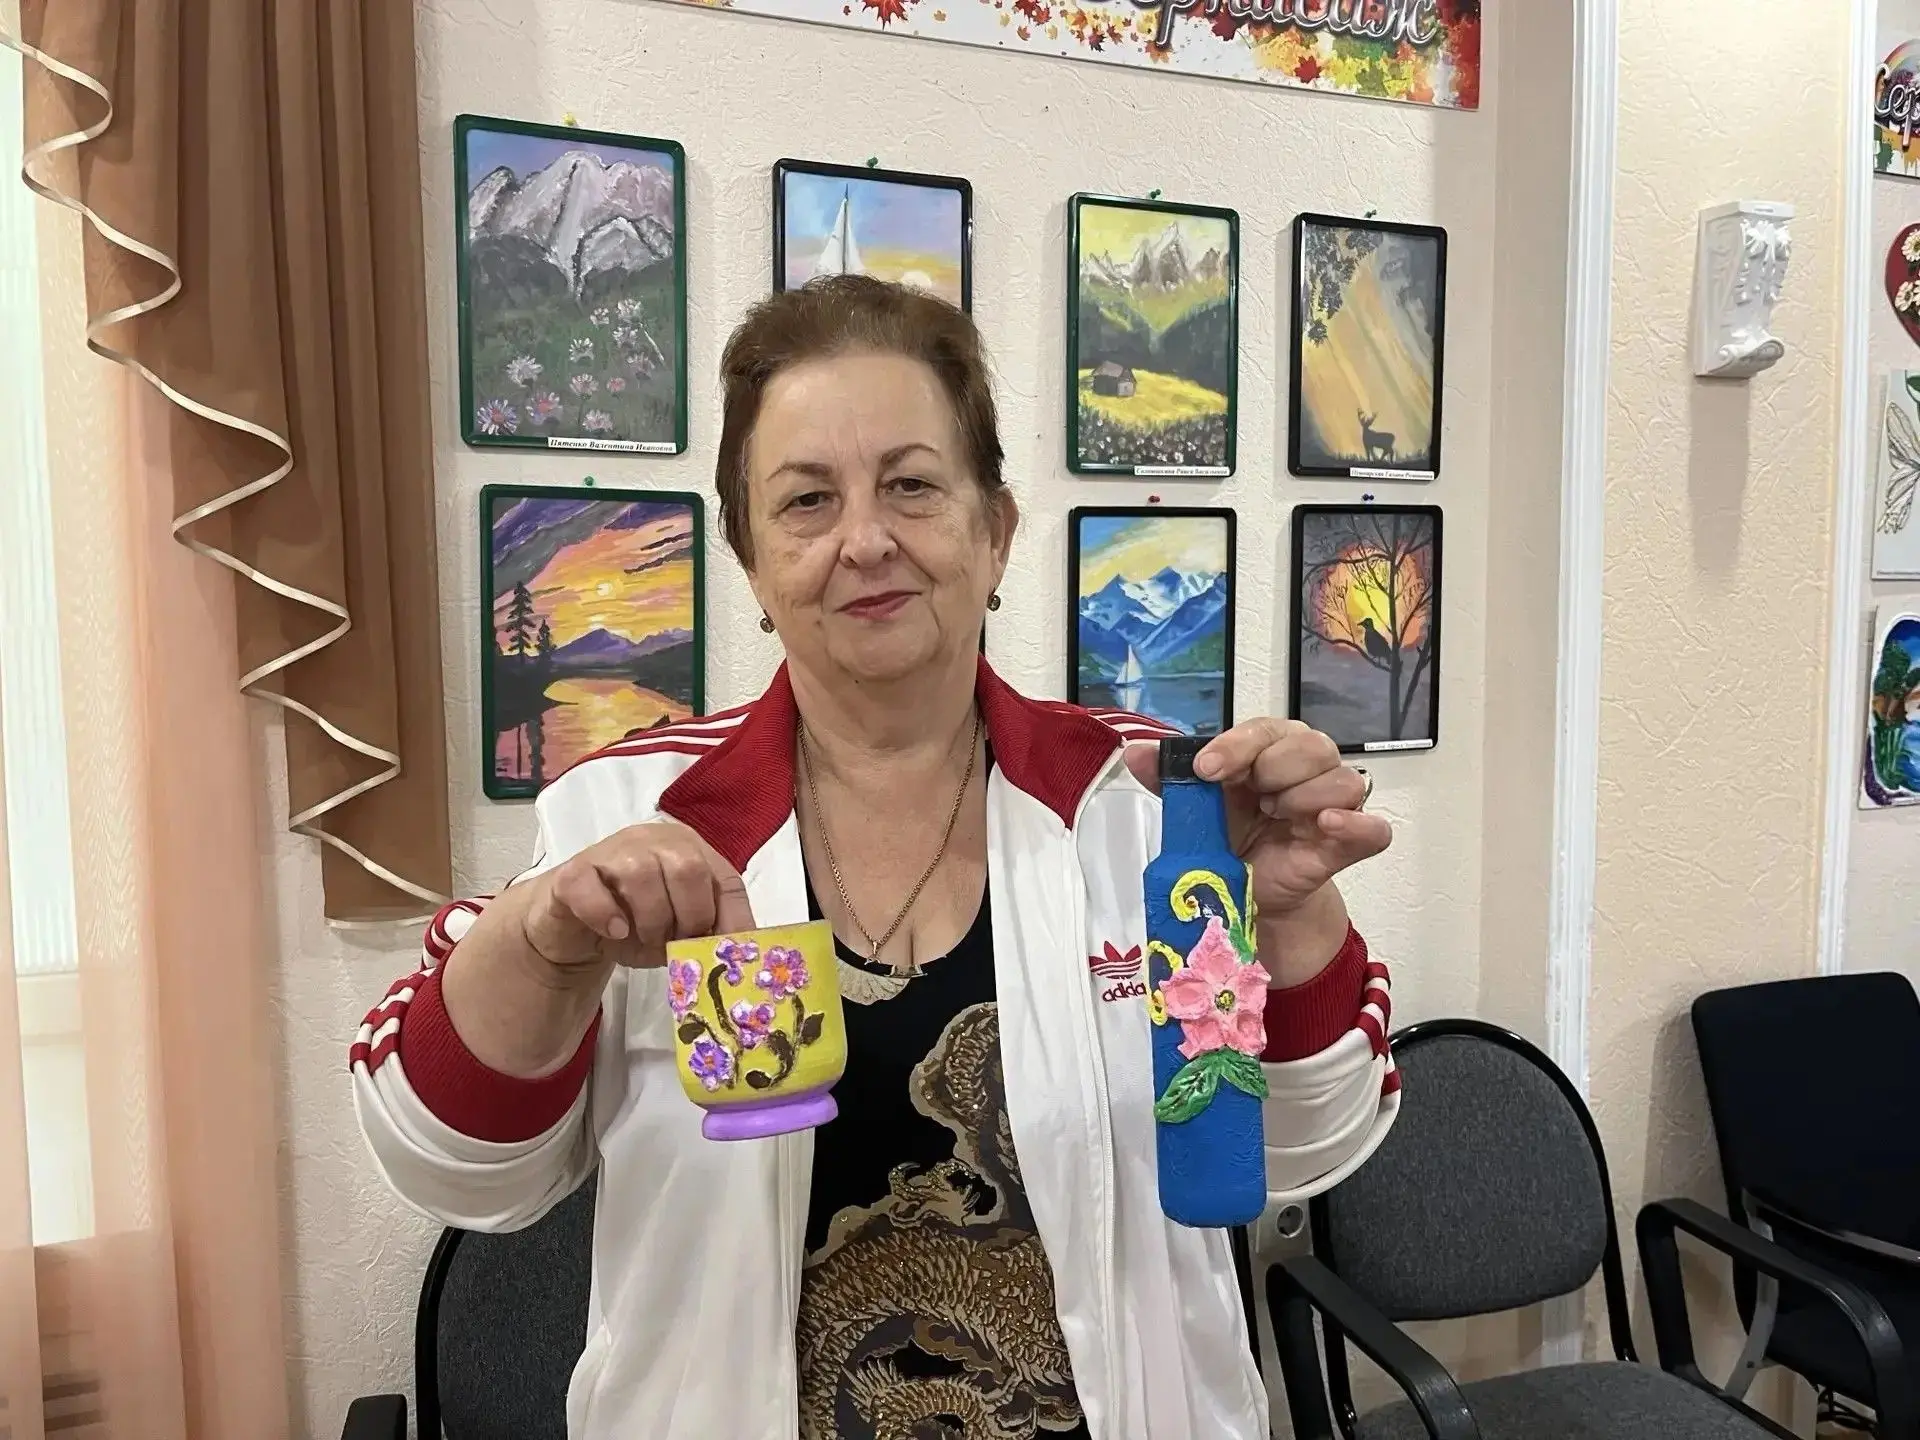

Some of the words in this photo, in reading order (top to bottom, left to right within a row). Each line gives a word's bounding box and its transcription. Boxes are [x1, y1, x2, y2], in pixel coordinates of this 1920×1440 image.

[589, 441, 634, 450] Валентина
[635, 443, 673, 452] Ивановна
[1102, 981, 1147, 1002] adida
